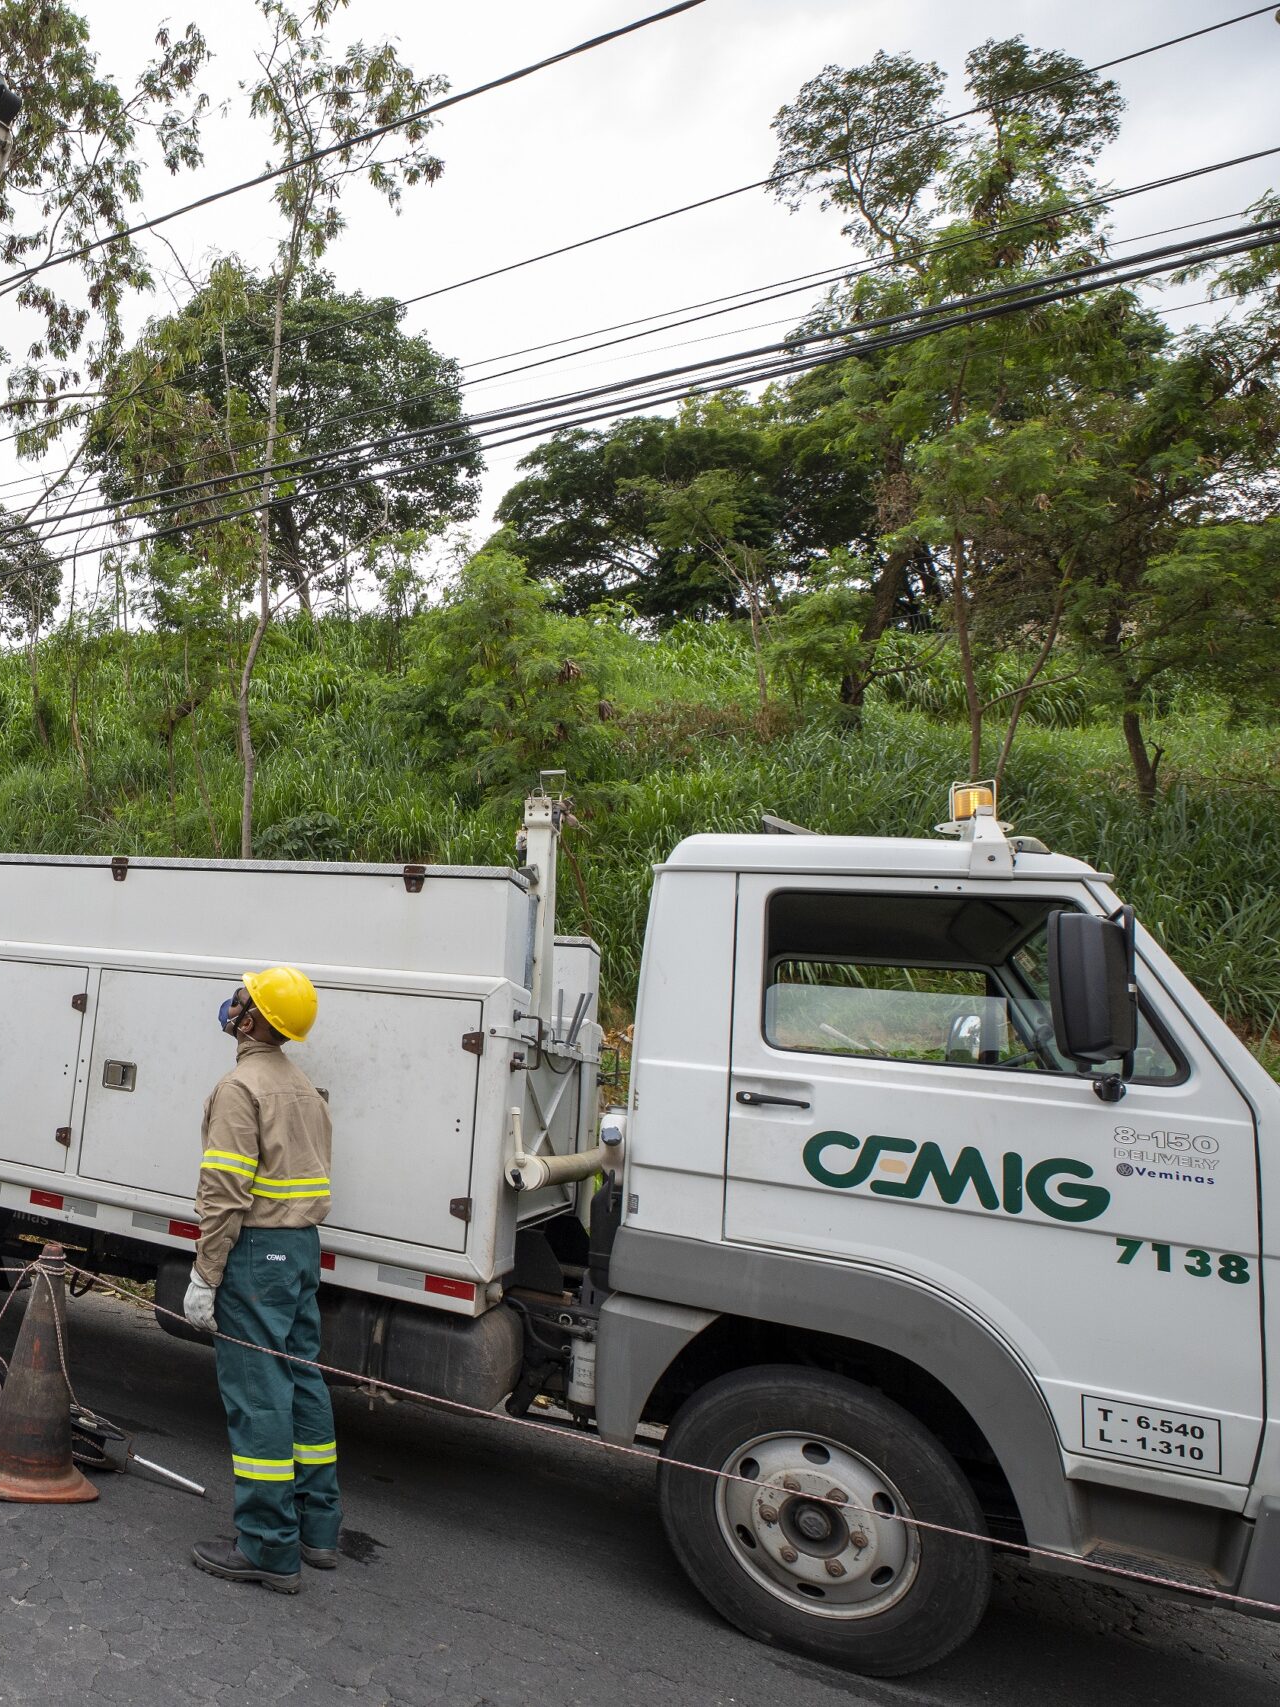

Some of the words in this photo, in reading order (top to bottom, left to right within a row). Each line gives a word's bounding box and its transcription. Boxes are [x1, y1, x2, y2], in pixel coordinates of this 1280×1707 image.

[1114, 1126, 1220, 1155] 8-150
[1114, 1147, 1220, 1171] DELIVERY
[1135, 1166, 1215, 1185] Veminas
[802, 1130, 1111, 1222] CEMIG
[1116, 1237, 1251, 1284] 7138
[1098, 1407, 1113, 1422] T
[1136, 1415, 1205, 1440] 6.540
[1099, 1428, 1113, 1443] L
[1136, 1436, 1204, 1461] 1.310
